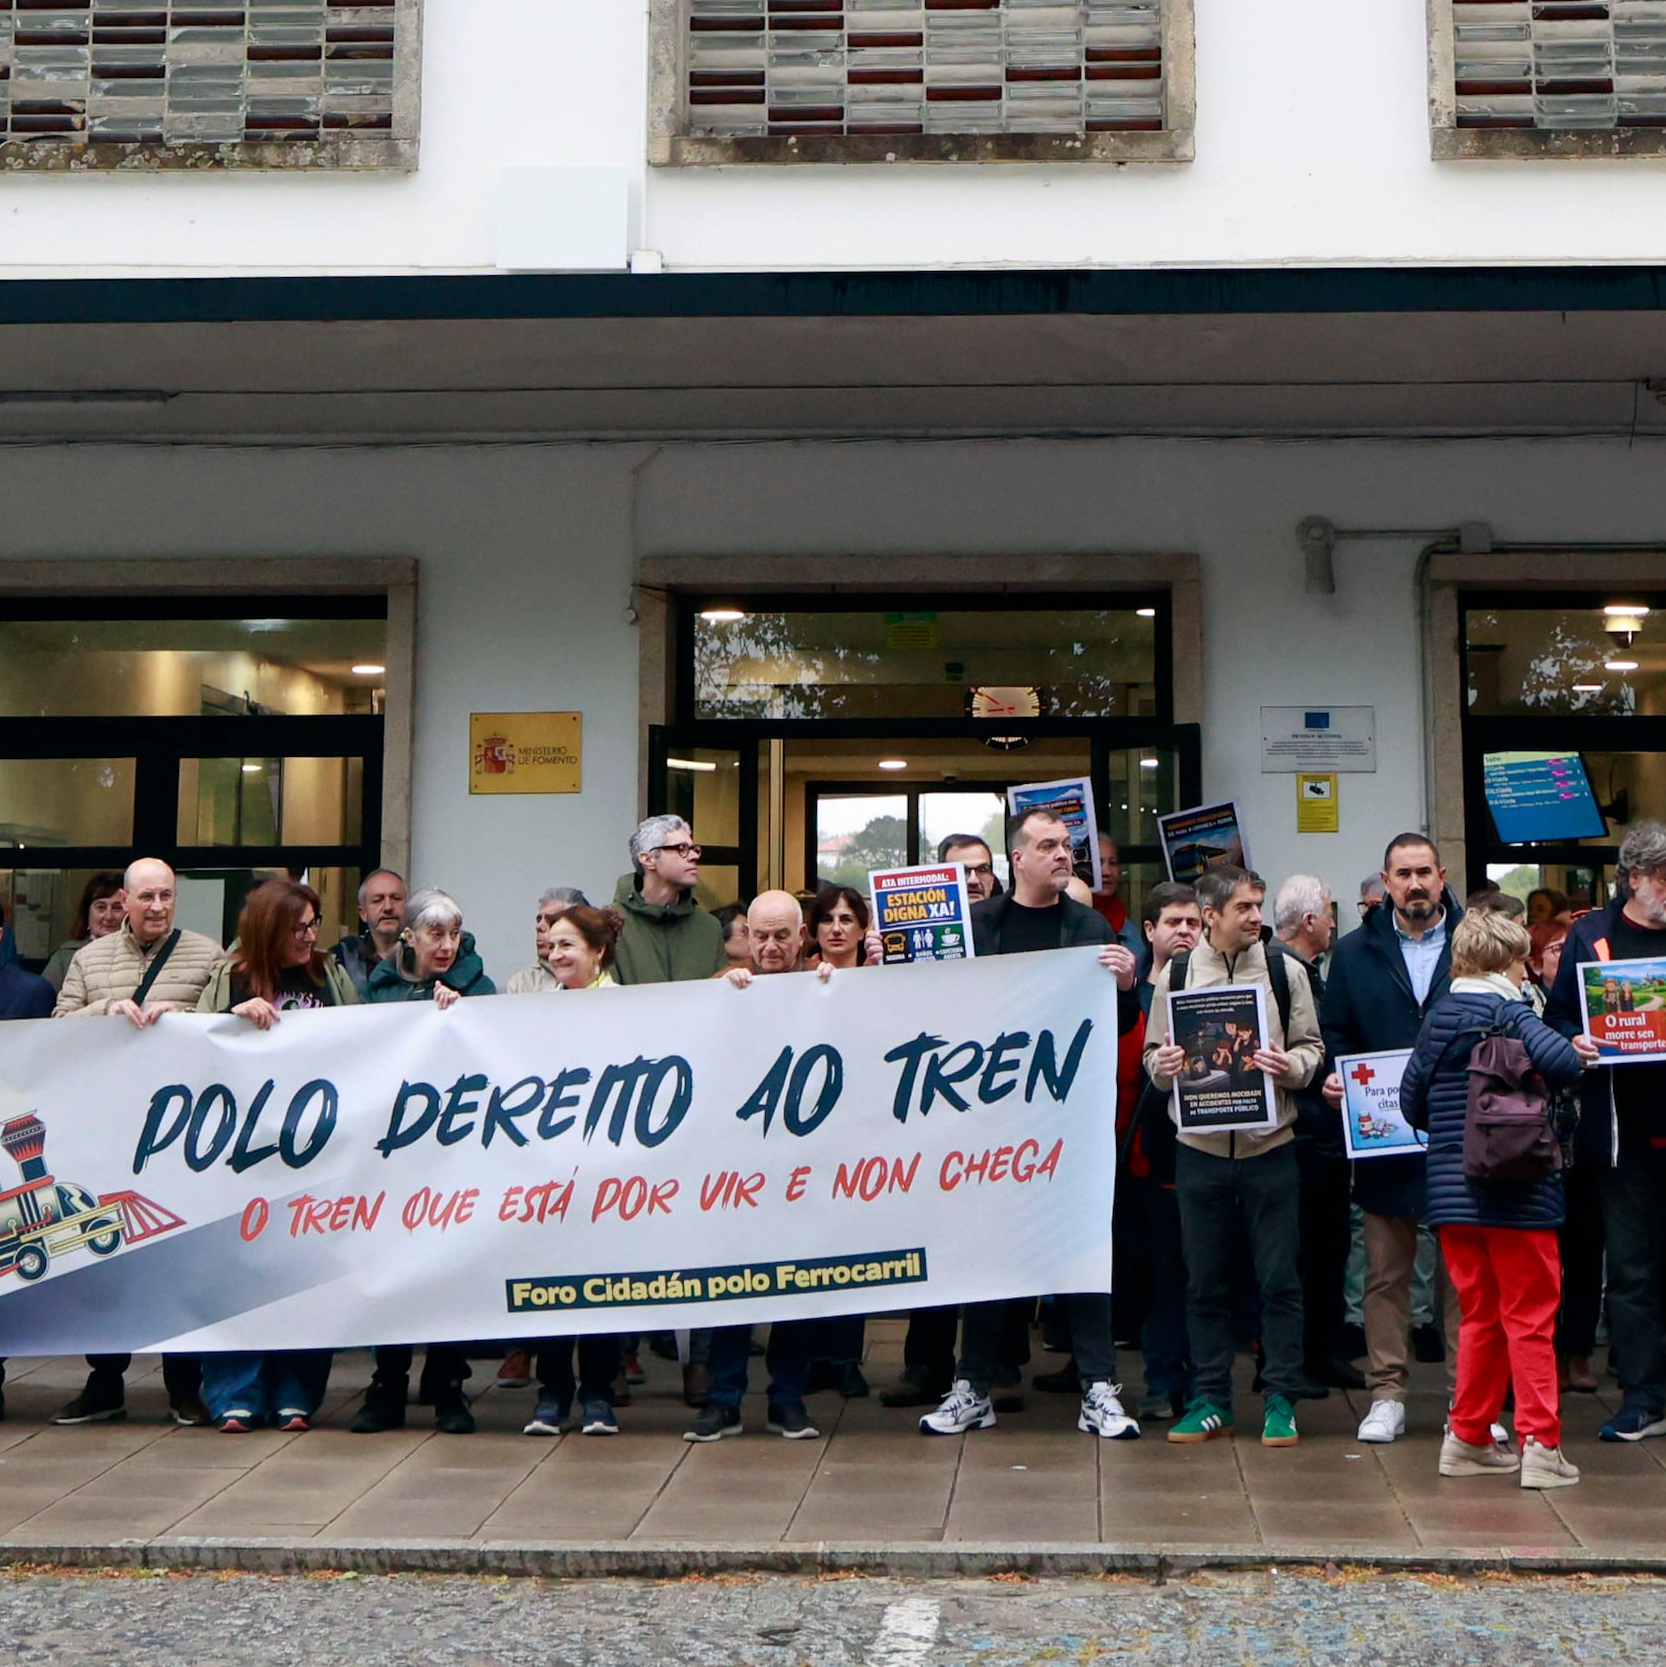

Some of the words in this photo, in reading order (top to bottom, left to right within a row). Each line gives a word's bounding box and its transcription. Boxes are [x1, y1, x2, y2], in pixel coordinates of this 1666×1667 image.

[518, 745, 568, 755] MINISTERIO
[518, 756, 531, 765] DE
[533, 756, 578, 765] FOMENTO
[881, 878, 896, 888] ATA
[897, 873, 949, 886] INTERMODAL:
[887, 887, 946, 907] ESTACIÓN
[883, 905, 928, 923] DIGNA
[928, 901, 955, 919] XA!
[1605, 1014, 1616, 1027] O
[1618, 1013, 1646, 1027] rural
[1605, 1030, 1635, 1041] morre
[1637, 1029, 1655, 1039] sen
[1620, 1039, 1666, 1052] transporte
[132, 1078, 339, 1175] POLO
[374, 1055, 694, 1160] DEREITO
[735, 1044, 843, 1138] AO
[884, 1019, 1094, 1124] TREN
[1198, 1091, 1230, 1100] QUEREMOS
[1231, 1089, 1262, 1098] MOCIDADE
[1365, 1086, 1385, 1097] Para
[1198, 1099, 1232, 1107] ACCIDENTES
[1378, 1099, 1398, 1110] citas
[1197, 1106, 1233, 1115] TRANSPORTE
[1234, 1104, 1259, 1112] PÚBLICO
[239, 1197, 269, 1242] O
[287, 1190, 386, 1238] TREN
[402, 1186, 481, 1235] QUE
[498, 1165, 580, 1225] ESTÁ
[591, 1175, 680, 1224] POR
[699, 1171, 767, 1212] VIR
[784, 1166, 812, 1202] E
[831, 1151, 922, 1202] NON
[939, 1138, 1064, 1192] CHEGA
[512, 1283, 577, 1307] Foro
[582, 1272, 702, 1303] Cidadán
[708, 1268, 771, 1301] polo
[776, 1253, 921, 1290] Ferrocarril
